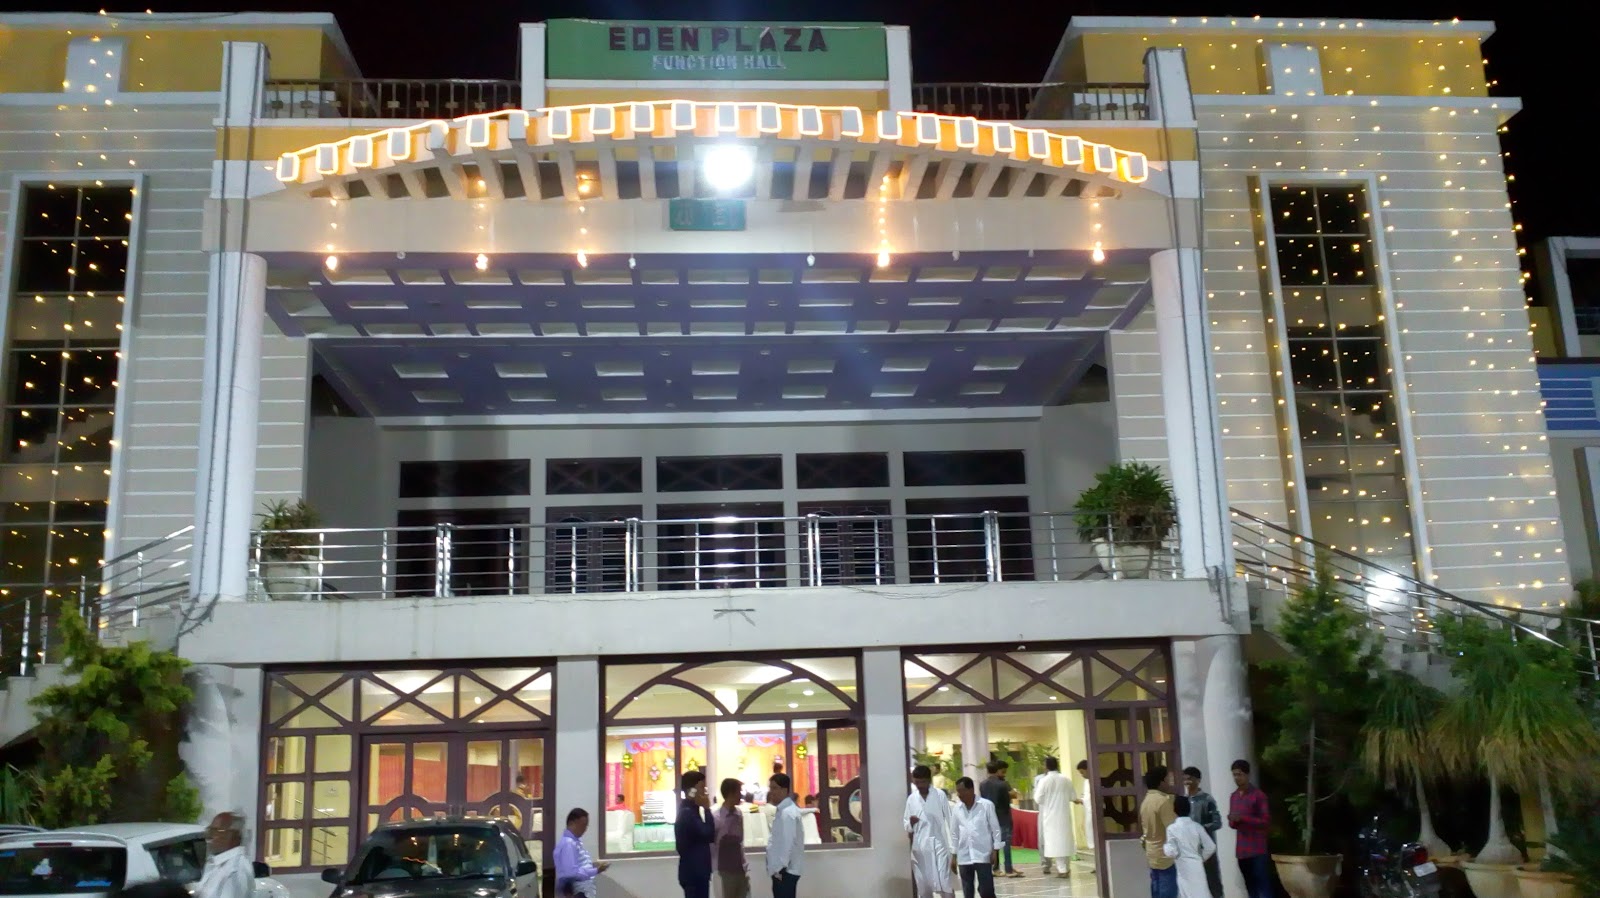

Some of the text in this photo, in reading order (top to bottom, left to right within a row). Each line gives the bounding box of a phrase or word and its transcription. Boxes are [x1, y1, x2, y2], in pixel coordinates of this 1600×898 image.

[609, 27, 827, 52] EDEN PLAZA
[652, 55, 786, 70] FUNCTION HALL
